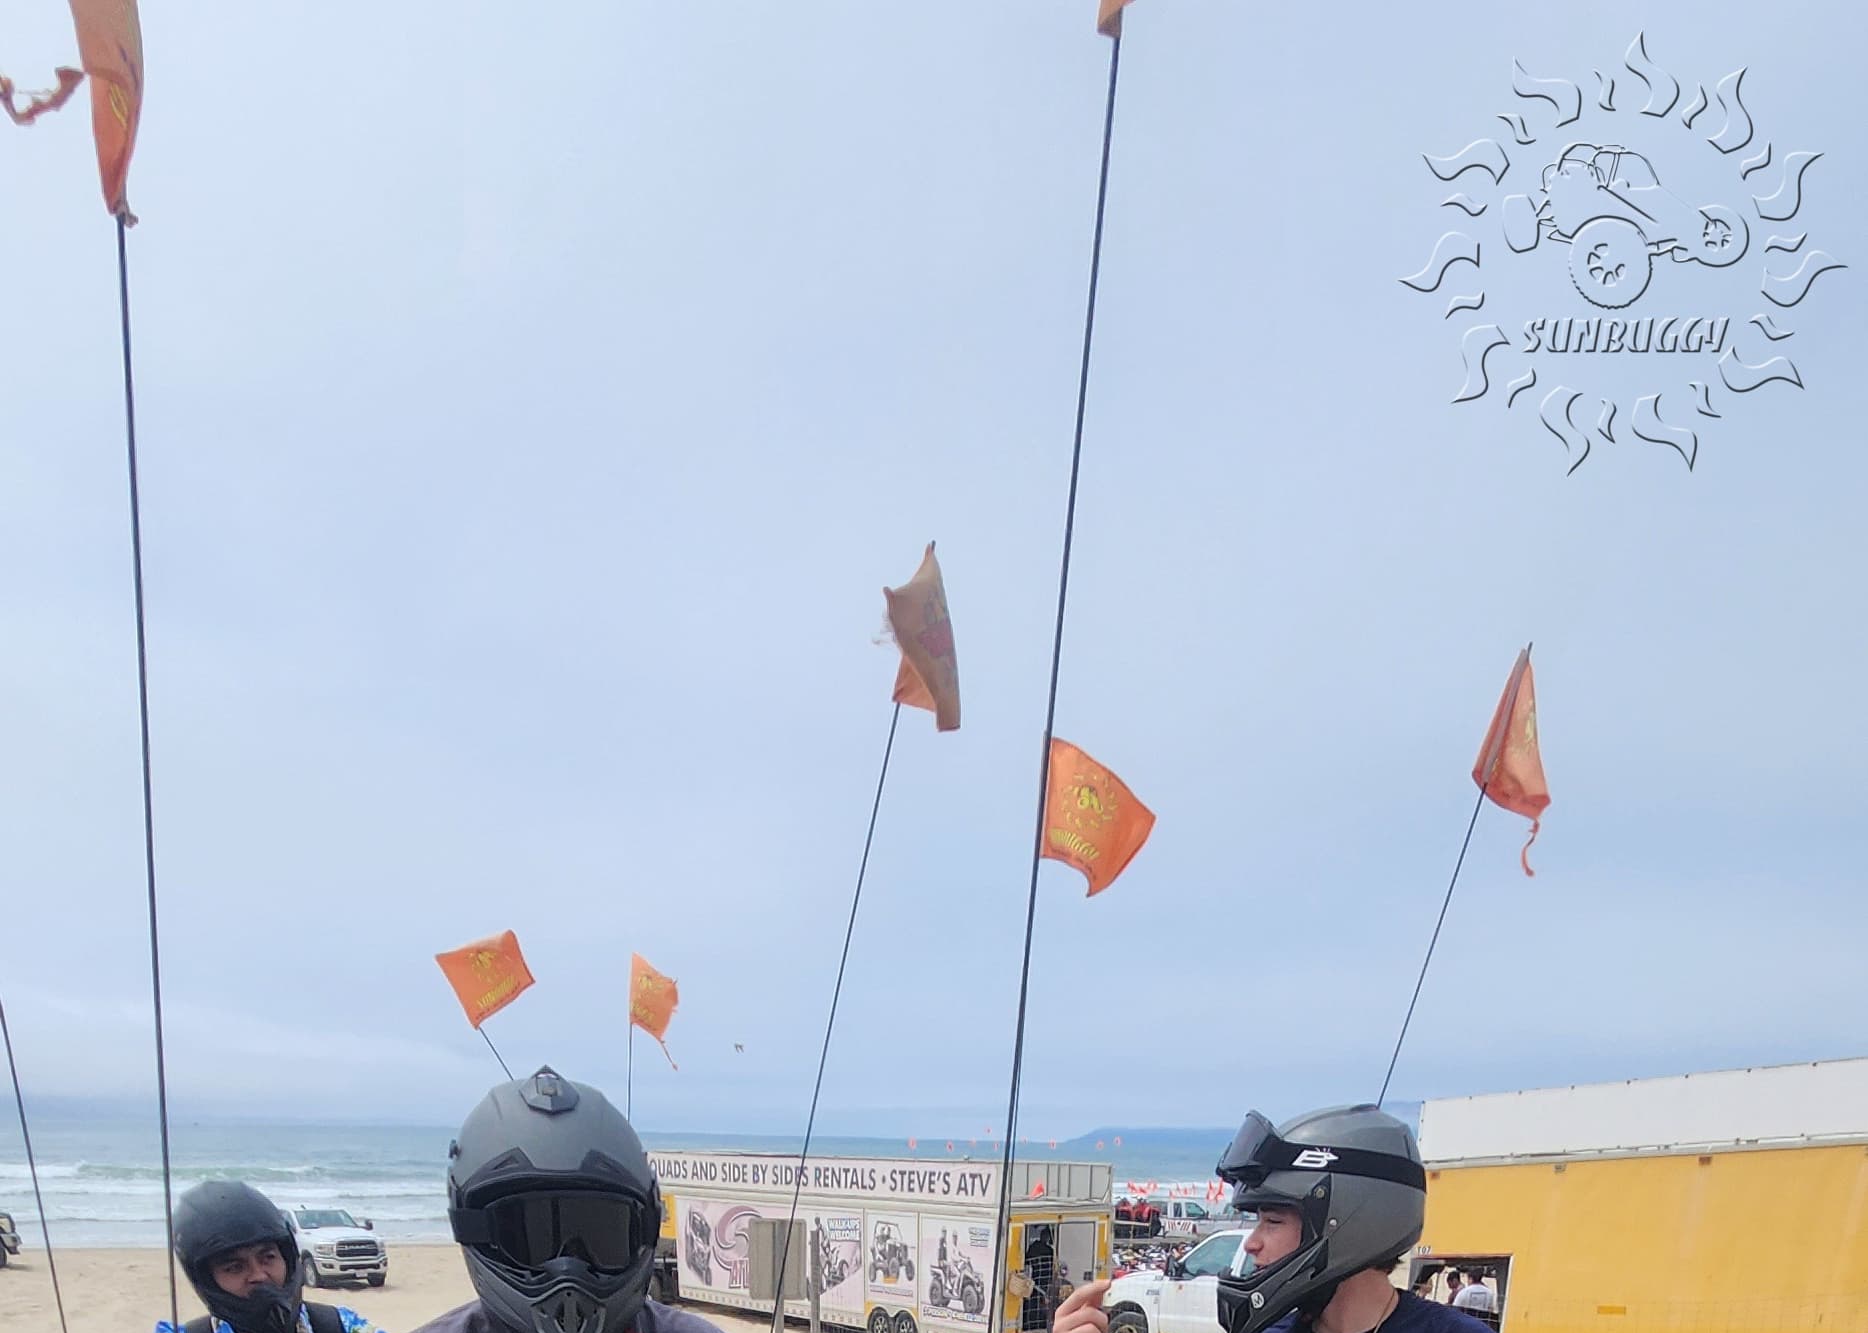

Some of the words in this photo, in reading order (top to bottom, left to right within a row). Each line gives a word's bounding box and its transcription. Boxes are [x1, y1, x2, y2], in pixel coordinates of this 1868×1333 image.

[691, 1161, 717, 1181] AND
[721, 1162, 748, 1183] SIDE
[752, 1164, 769, 1185] BY
[814, 1167, 876, 1191] RENTALS
[956, 1173, 991, 1197] ATV
